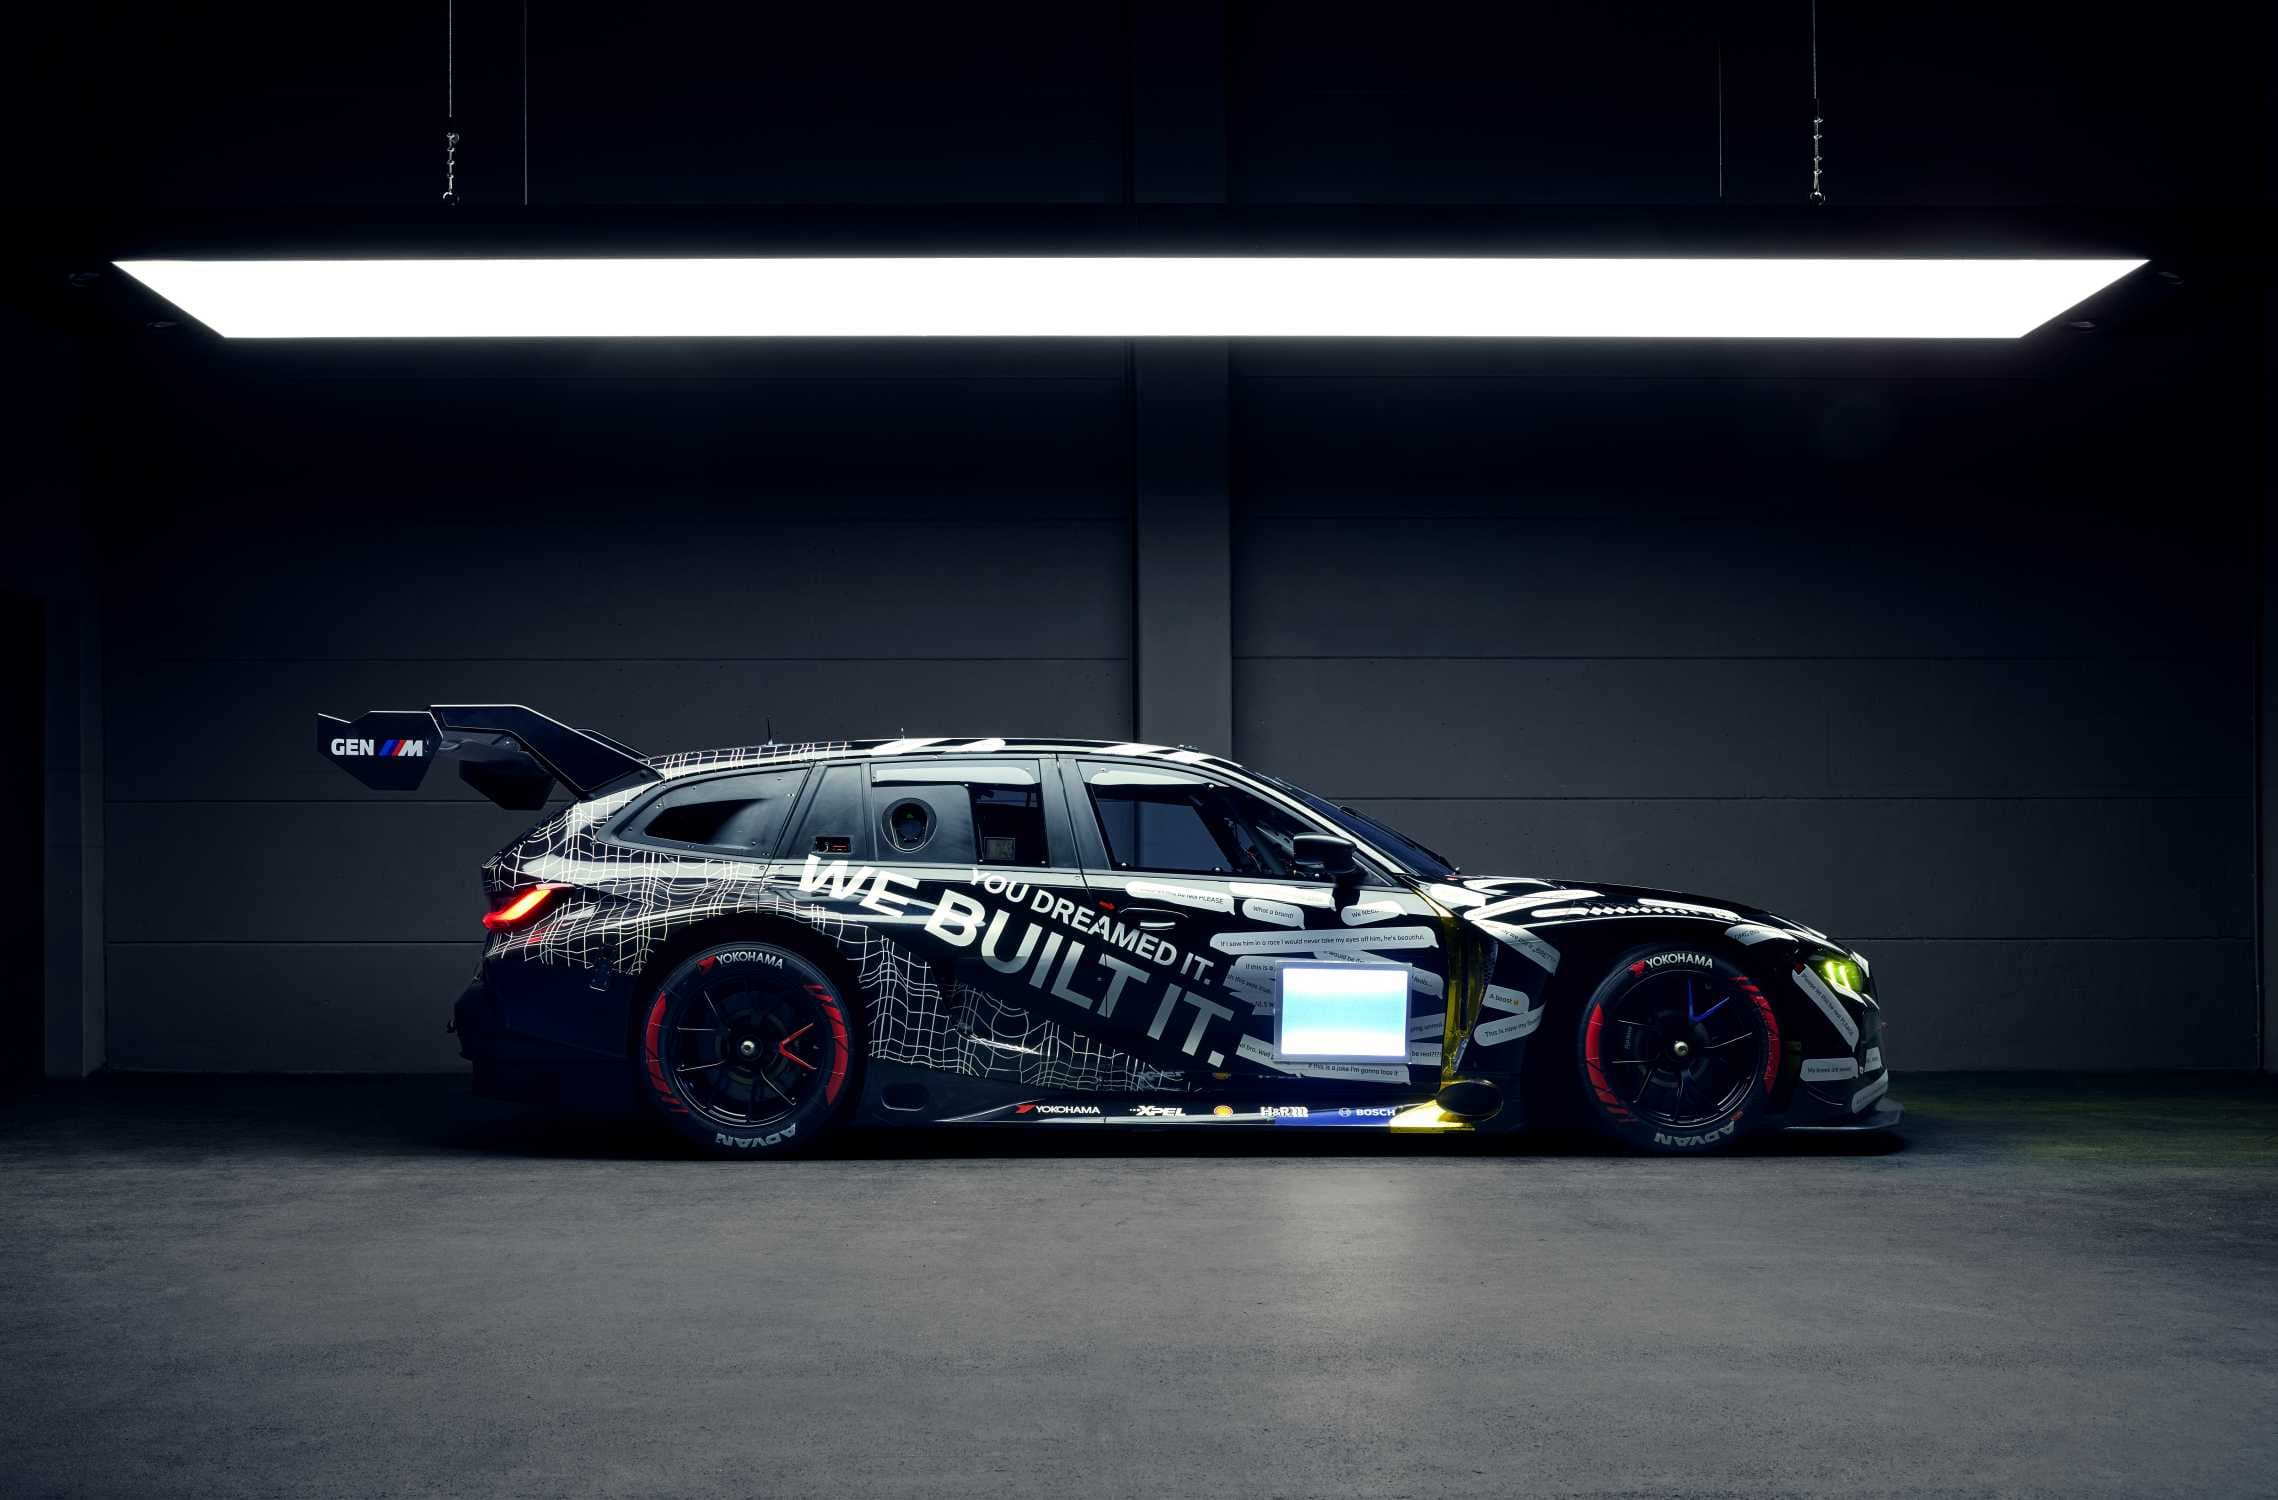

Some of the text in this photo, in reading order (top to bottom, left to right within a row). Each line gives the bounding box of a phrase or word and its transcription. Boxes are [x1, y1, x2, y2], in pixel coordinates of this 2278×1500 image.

[331, 739, 375, 756] GEN
[798, 854, 920, 917] WE
[1199, 896, 1224, 905] PLEASE
[969, 868, 1216, 986] YOU DREAMED IT.
[716, 951, 783, 969] YOKOHAMA
[1645, 953, 1713, 968] YOKOHAMA
[924, 889, 1234, 1069] BUILT IT.
[1035, 1105, 1101, 1114] YOKOHAMA
[1135, 1105, 1187, 1116] XPEL
[1356, 1108, 1396, 1117] BOSCH
[715, 1122, 796, 1148] ADVAN
[1654, 1120, 1735, 1146] ADVAN
